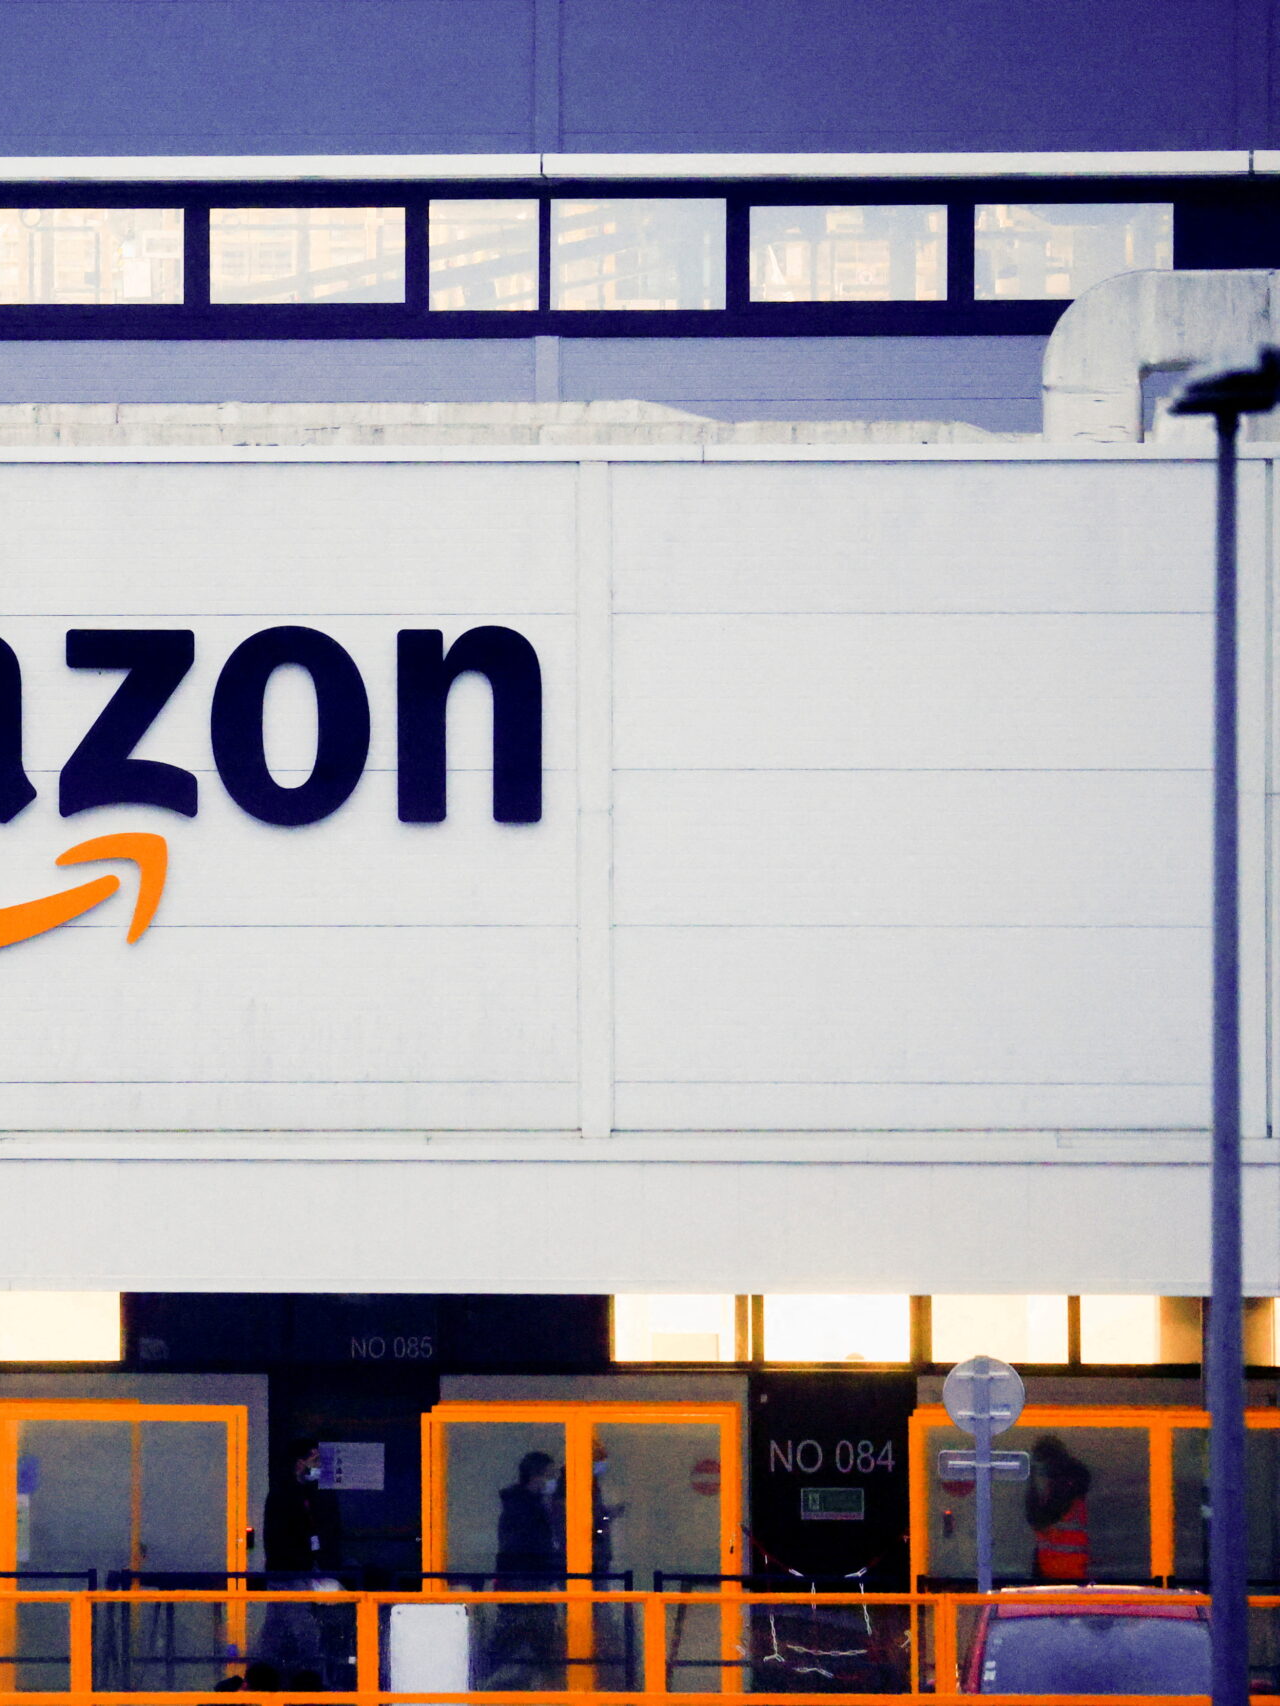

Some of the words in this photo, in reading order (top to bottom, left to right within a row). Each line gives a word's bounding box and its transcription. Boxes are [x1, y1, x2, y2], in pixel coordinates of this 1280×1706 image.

[351, 1336, 386, 1359] NO
[393, 1336, 433, 1359] 085
[769, 1439, 823, 1473] NO
[835, 1439, 896, 1473] 084
